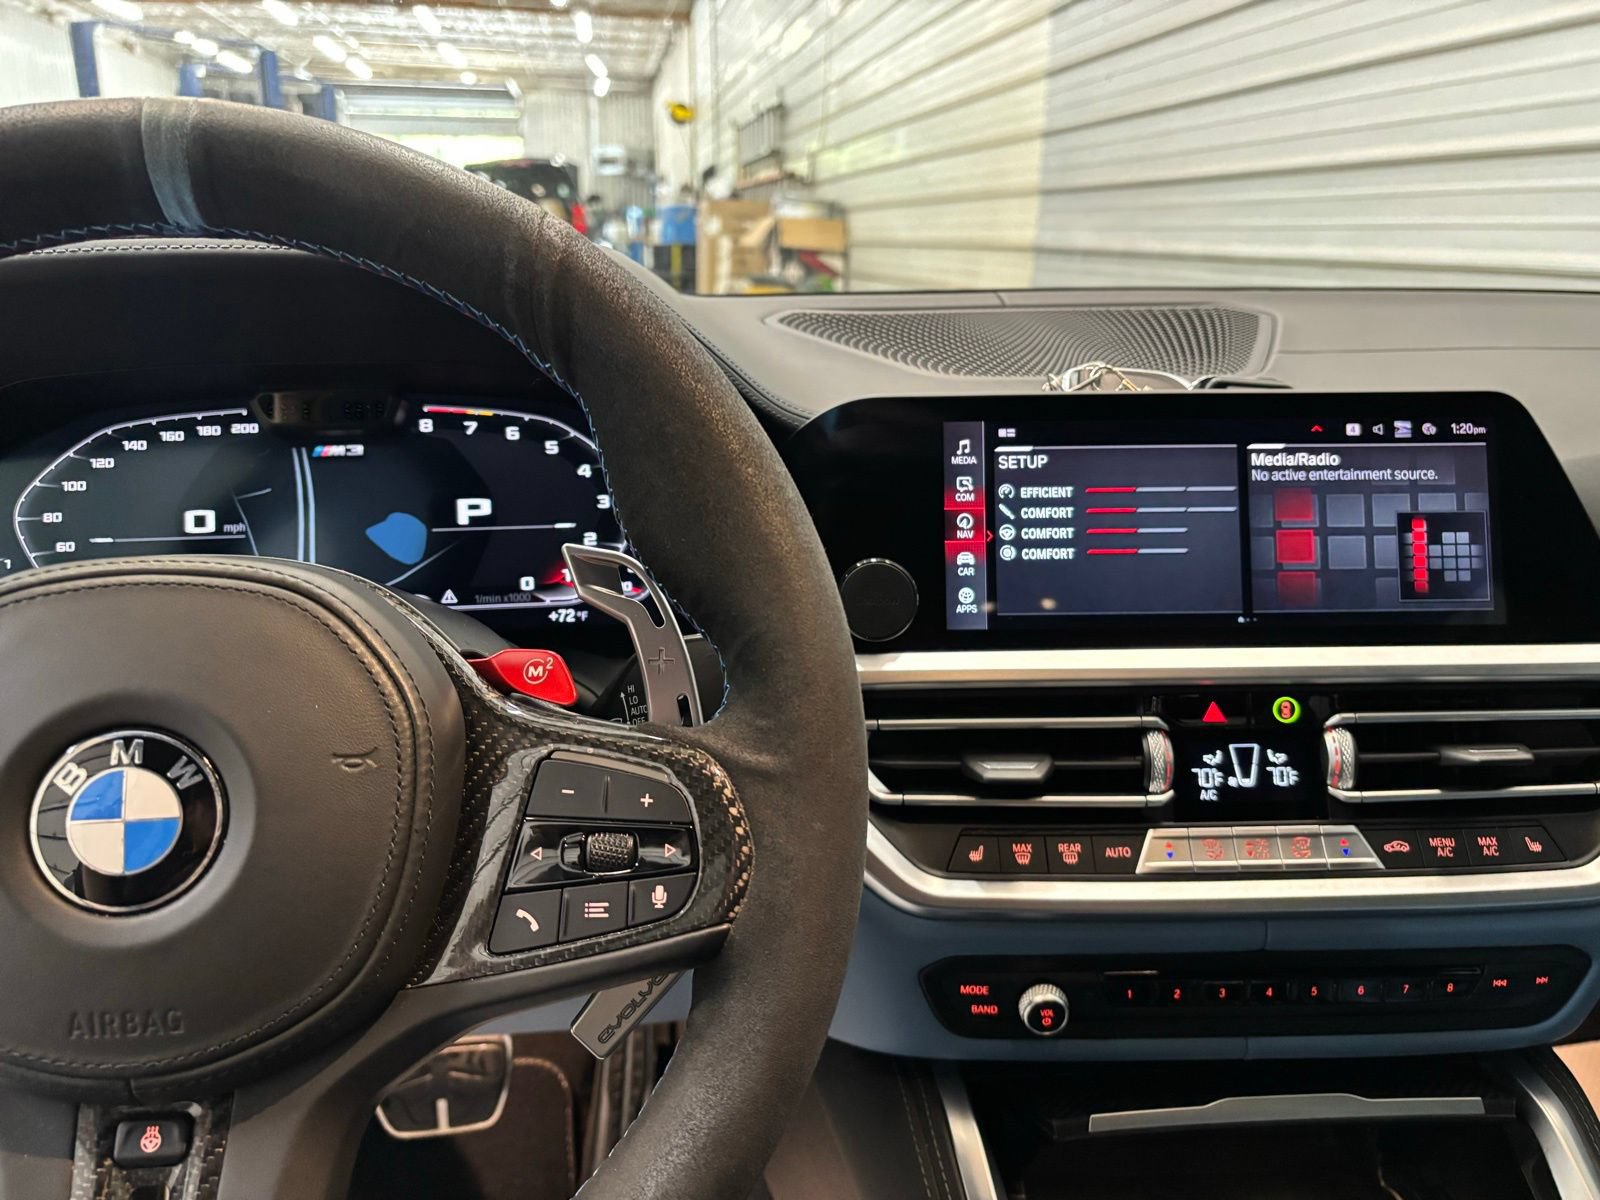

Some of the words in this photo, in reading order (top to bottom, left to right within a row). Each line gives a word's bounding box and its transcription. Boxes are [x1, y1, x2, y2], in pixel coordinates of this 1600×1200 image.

[196, 425, 221, 437] 180
[230, 423, 259, 434] 200
[418, 419, 434, 433] 8
[463, 421, 478, 435] 7
[159, 431, 185, 442] 160
[505, 426, 520, 441] 6
[122, 440, 147, 451] 140
[544, 440, 560, 455] 5
[90, 458, 115, 469] 120
[951, 456, 977, 465] MEDIA
[998, 455, 1048, 469] SETUP
[1251, 452, 1341, 467] Media/Radio
[577, 463, 592, 478] 4
[1251, 468, 1269, 481] No
[1271, 467, 1307, 481] active
[1309, 467, 1392, 481] entertainment
[1394, 468, 1439, 480] source.
[61, 481, 87, 492] 100
[955, 493, 975, 502] COM
[1020, 486, 1074, 499] EFFICIENT
[597, 494, 610, 509] 3
[456, 498, 492, 525] P
[1021, 507, 1074, 519] COMFORT
[42, 512, 62, 523] 80
[183, 509, 216, 534] 0
[223, 522, 246, 534] mph
[583, 532, 597, 546] 2
[956, 530, 974, 540] NAV
[1021, 527, 1074, 540] COMFORT
[56, 542, 76, 553] 60
[1021, 547, 1075, 560] COMFORT
[957, 567, 975, 577] CAR
[519, 576, 535, 591] 0
[955, 604, 978, 614] APPS
[627, 684, 635, 693] HI
[629, 695, 639, 705] LO
[53, 738, 203, 796] BMW
[1200, 790, 1219, 801] A/C
[1429, 837, 1455, 847] MENU
[1477, 836, 1498, 846] MAX
[1012, 843, 1032, 853] MAX
[1058, 843, 1081, 853] REAR
[1105, 846, 1132, 859] AUTO
[1436, 847, 1454, 857] A/C
[1482, 846, 1499, 856] A/C
[960, 984, 990, 995] MODE
[1219, 987, 1226, 998] 3
[1265, 986, 1273, 997] 4
[1311, 985, 1318, 996] 5
[1357, 984, 1364, 995] 6
[1402, 983, 1409, 994] 7
[1446, 982, 1454, 993] 8
[1127, 988, 1133, 999] 1
[1174, 988, 1181, 999] 2
[971, 1003, 998, 1015] BAND
[1040, 1008, 1054, 1017] VOL
[69, 1010, 185, 1040] AIRBAG
